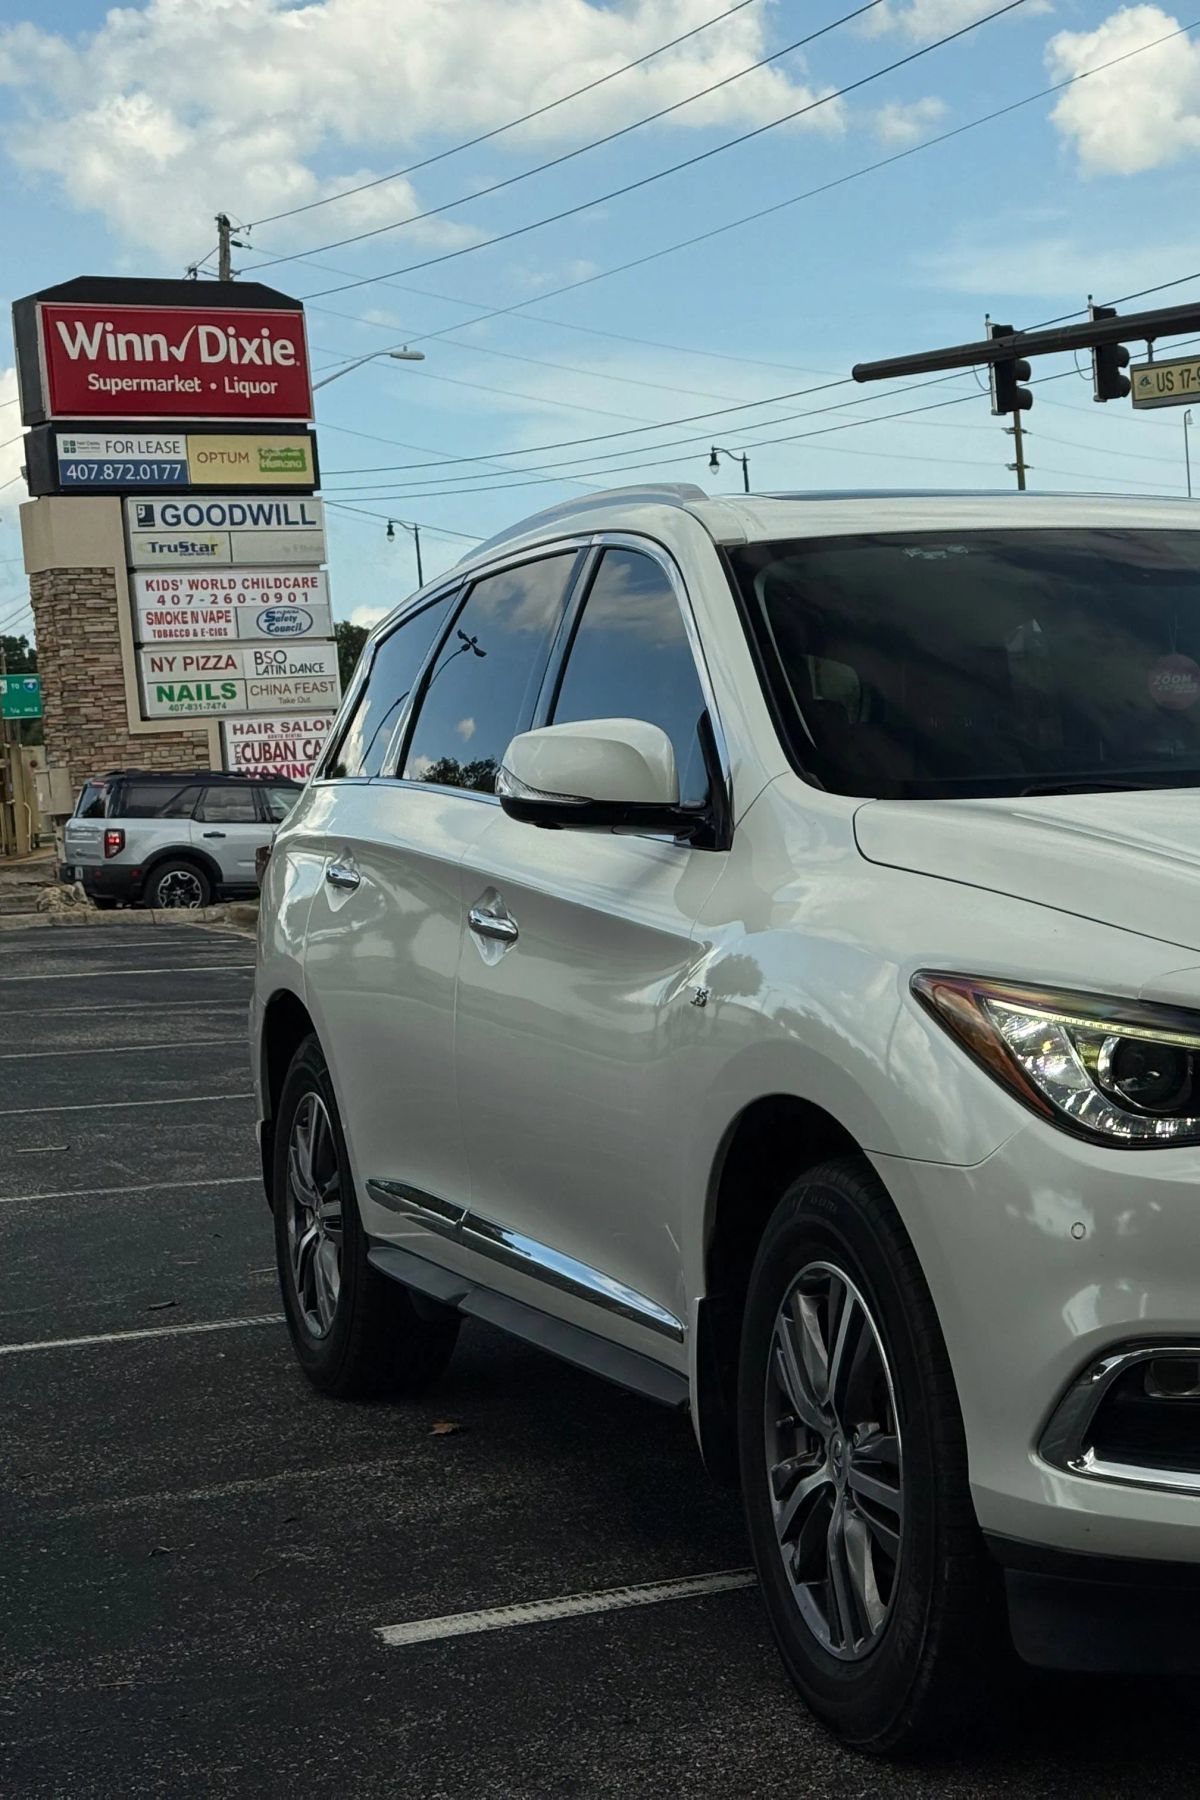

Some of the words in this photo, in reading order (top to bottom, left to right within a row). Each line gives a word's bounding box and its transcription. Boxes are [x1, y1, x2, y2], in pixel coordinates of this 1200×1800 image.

[55, 321, 167, 361] Winn
[198, 324, 296, 366] Dixie
[87, 373, 202, 395] Supermarket
[224, 376, 279, 398] Liquor
[1156, 370, 1175, 392] US
[105, 440, 136, 454] FOR
[138, 440, 180, 454] LEASE
[197, 452, 249, 464] OPTUM
[66, 463, 182, 481] 407.872.0177
[161, 503, 317, 527] GOODWILL
[148, 541, 218, 553] TruStar
[145, 578, 183, 592] KIDS'
[187, 577, 237, 591] WORLD
[241, 576, 319, 590] CHILDCARE
[146, 610, 189, 626] SMOKE
[190, 610, 199, 624] N
[200, 609, 232, 624] VAPE
[152, 628, 191, 639] TOBACCO
[193, 628, 198, 637] &
[200, 627, 228, 638] E-CIGS
[266, 622, 302, 632] Council
[150, 655, 177, 673] NY
[182, 654, 238, 672] PIZZA
[254, 650, 287, 665] BSO
[256, 664, 286, 675] LATIN
[289, 662, 325, 674] DANCE
[156, 683, 237, 703] NAILS
[250, 683, 291, 697] CHINA
[294, 681, 336, 694] FEAST
[232, 723, 275, 735] HAIR
[241, 740, 297, 763] CUBAN
